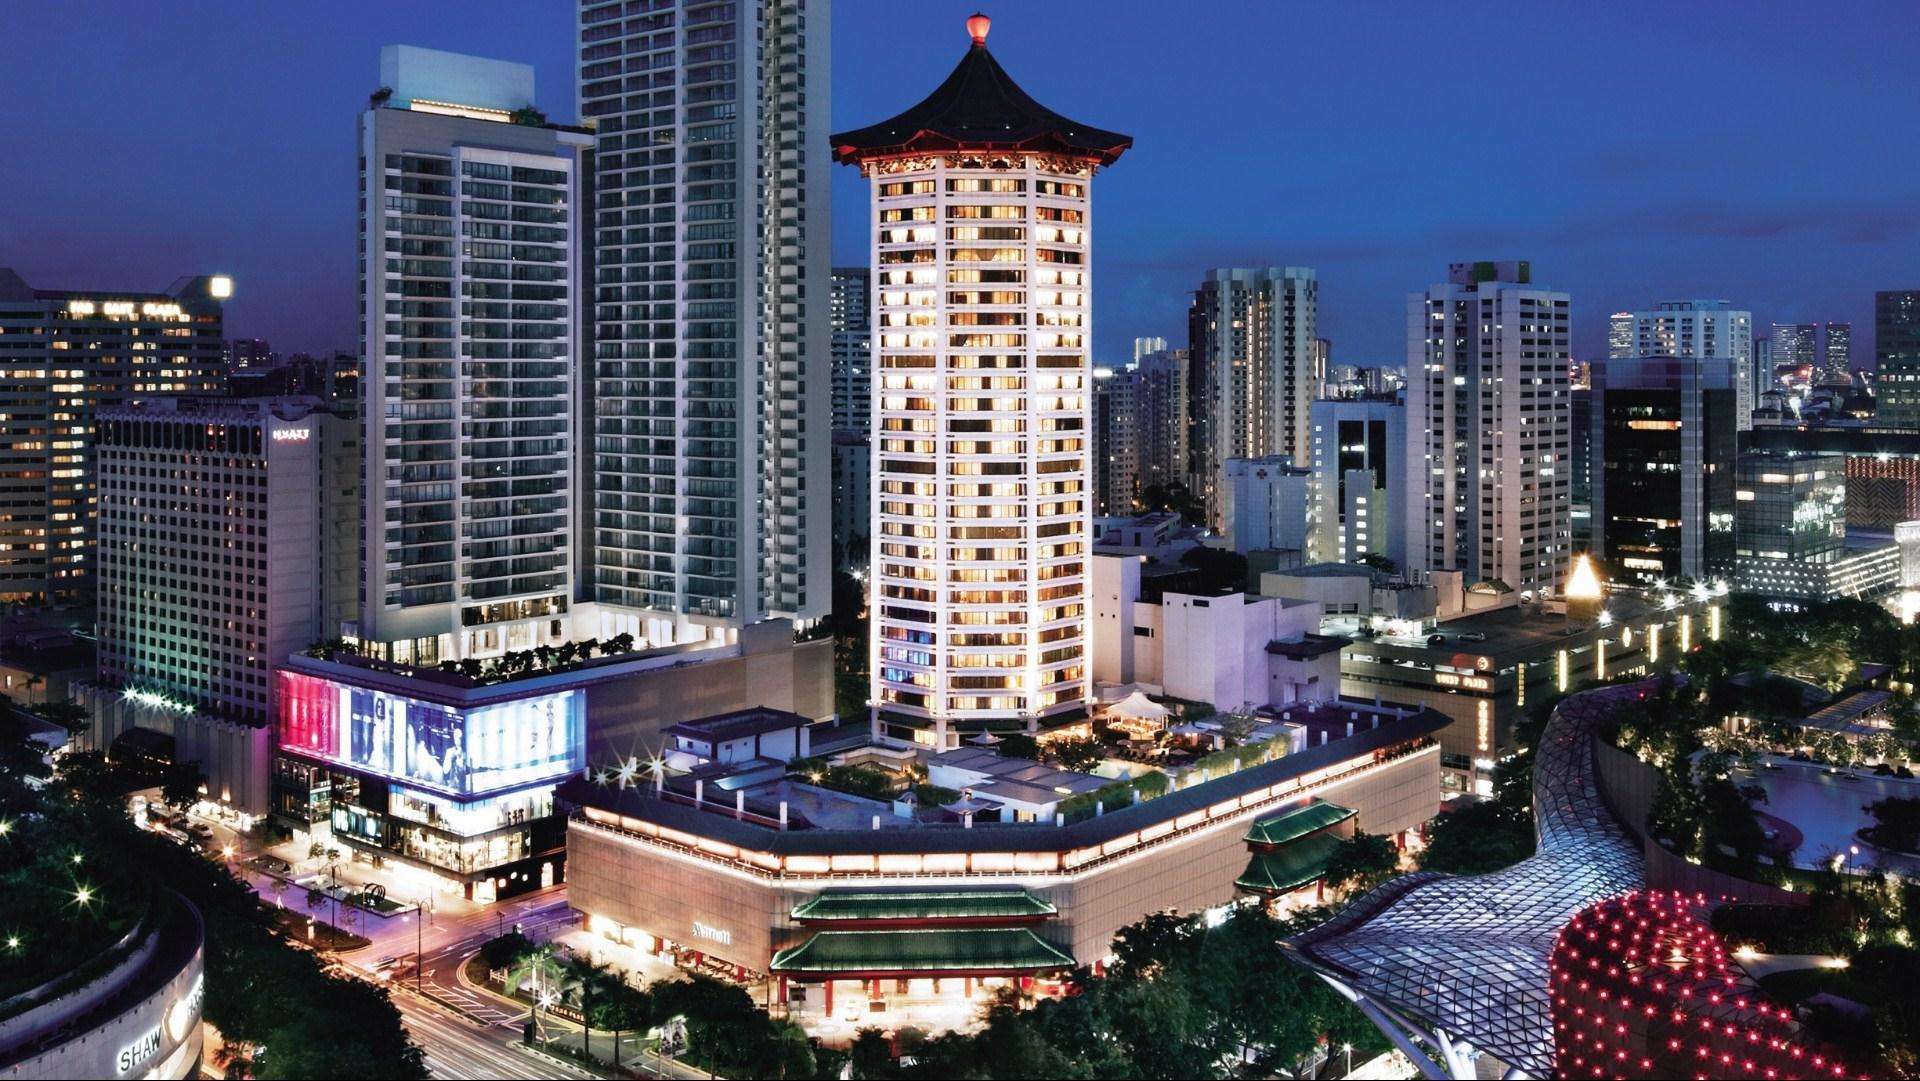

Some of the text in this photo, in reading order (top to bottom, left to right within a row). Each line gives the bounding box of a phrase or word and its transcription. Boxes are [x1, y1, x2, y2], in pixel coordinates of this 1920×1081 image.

[69, 301, 181, 317] FAR EAST PLAZA
[272, 429, 309, 440] HYATT
[692, 921, 731, 945] Marriott
[119, 1026, 162, 1072] SHAW
